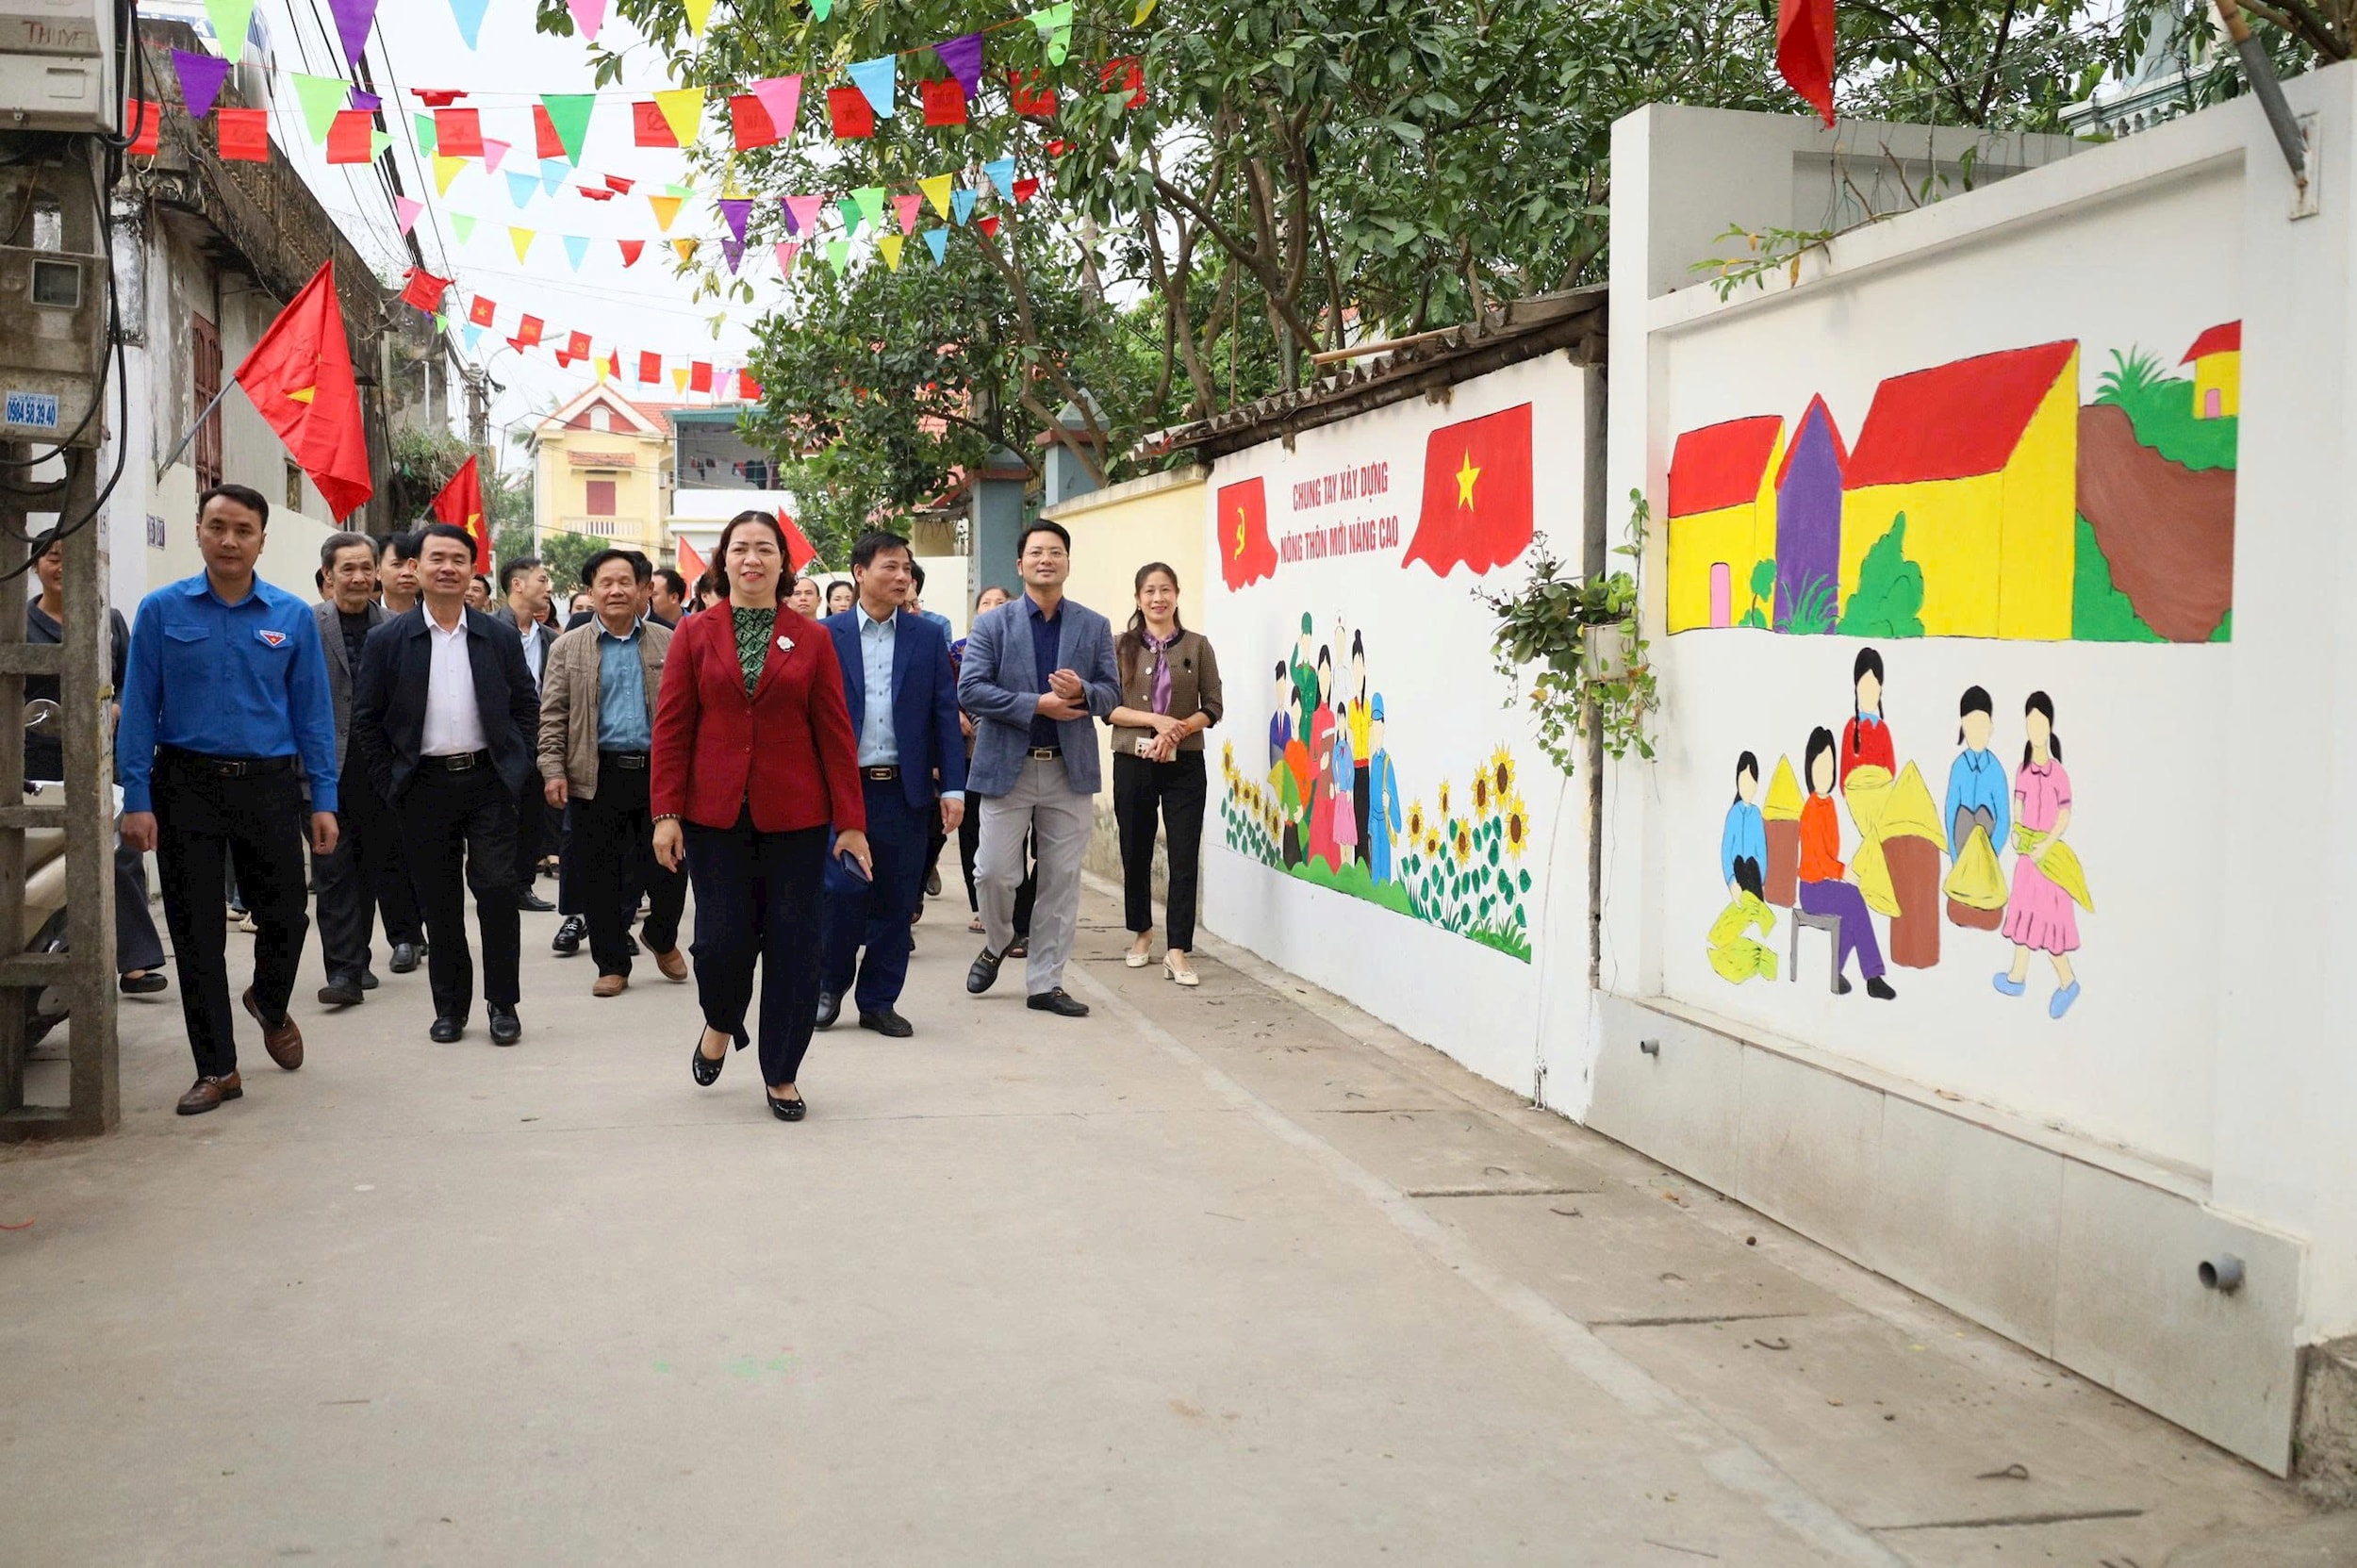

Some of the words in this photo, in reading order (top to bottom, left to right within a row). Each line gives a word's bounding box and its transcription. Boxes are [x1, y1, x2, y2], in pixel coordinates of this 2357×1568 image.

[8, 400, 56, 426] 0984.58.39.40
[1293, 478, 1321, 512] CHUNG
[1324, 473, 1337, 504] TAY
[1340, 464, 1358, 502] XÂY
[1360, 461, 1388, 503] DỰNG
[1280, 530, 1302, 563] NÔNG
[1305, 524, 1327, 560] THÔN
[1329, 520, 1346, 556] MỚI
[1349, 516, 1376, 554] NÂNG
[1378, 515, 1398, 548] CAO
